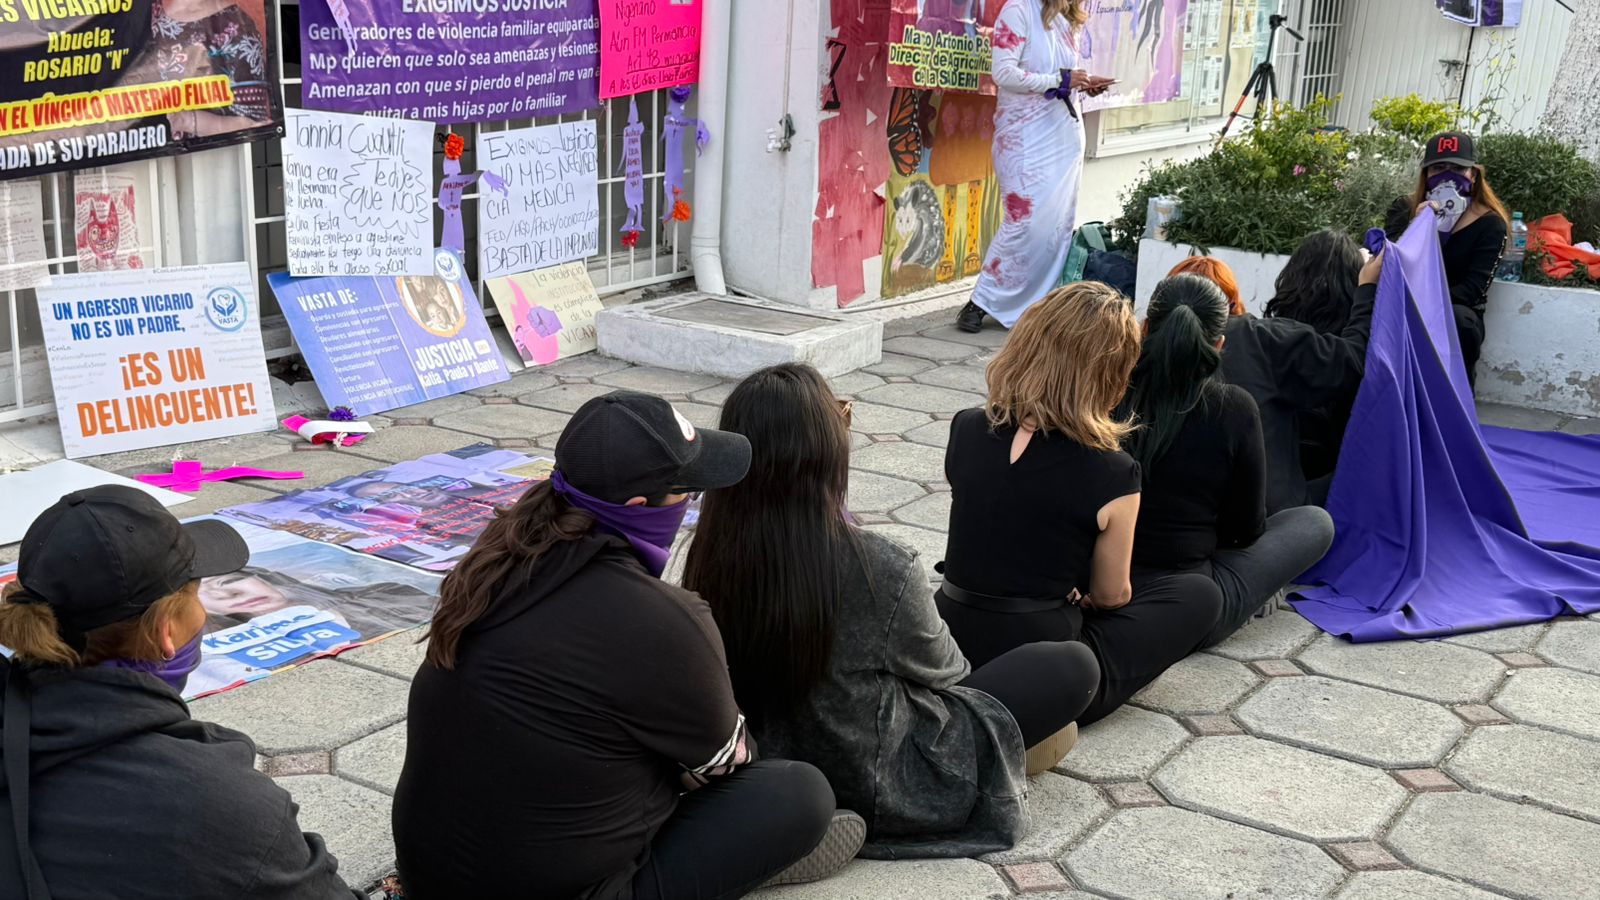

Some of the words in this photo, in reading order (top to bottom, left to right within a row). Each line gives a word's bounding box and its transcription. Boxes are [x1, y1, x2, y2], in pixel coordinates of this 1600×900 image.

[48, 27, 115, 53] Abuela:
[309, 23, 412, 40] Genradores
[417, 22, 435, 39] de
[438, 22, 498, 40] violencia
[501, 19, 544, 37] familiar
[547, 15, 599, 34] equiparada
[24, 53, 101, 82] ROSARIO
[106, 48, 129, 71] "N"
[310, 53, 337, 72] Mp
[342, 52, 401, 73] quieren
[405, 54, 434, 72] que
[437, 51, 464, 67] solo
[470, 52, 490, 66] sea
[494, 47, 548, 64] amenazas
[551, 47, 557, 61] y
[309, 81, 391, 98] Amenazan
[395, 81, 420, 95] con
[425, 80, 452, 96] que
[455, 75, 467, 91] si
[470, 73, 512, 93] pierdo
[514, 71, 525, 88] el
[527, 69, 556, 90] penal
[559, 69, 575, 83] me
[578, 68, 594, 79] van
[12, 104, 28, 128] EL
[33, 96, 101, 126] VÍNCULO
[105, 85, 181, 116] MATERNO
[184, 79, 230, 106] FILIAL
[411, 107, 419, 119] a
[424, 103, 448, 118] mis
[453, 100, 485, 118] hijas
[487, 100, 507, 118] por
[512, 96, 523, 112] lo
[525, 93, 567, 111] familiar
[39, 144, 55, 166] DE
[61, 139, 82, 162] SU
[87, 124, 167, 157] PARADERO
[317, 167, 338, 181] era
[519, 160, 556, 187] MAS
[486, 199, 510, 219] CIA
[524, 182, 575, 213] MEDICA
[52, 303, 73, 320] UN
[77, 297, 139, 318] AGRESOR
[141, 292, 194, 312] VICARIO
[297, 291, 338, 312] VASTA
[338, 288, 359, 304] DE:
[71, 322, 91, 341] NO
[95, 320, 112, 339] ES
[115, 318, 135, 337] UN
[140, 315, 185, 333] PADRE,
[119, 351, 162, 390] ¡ES
[168, 346, 206, 382] UN
[415, 338, 477, 371] JUSTICIA
[442, 365, 469, 382] Paula
[77, 383, 257, 438] DELINCUENTE!
